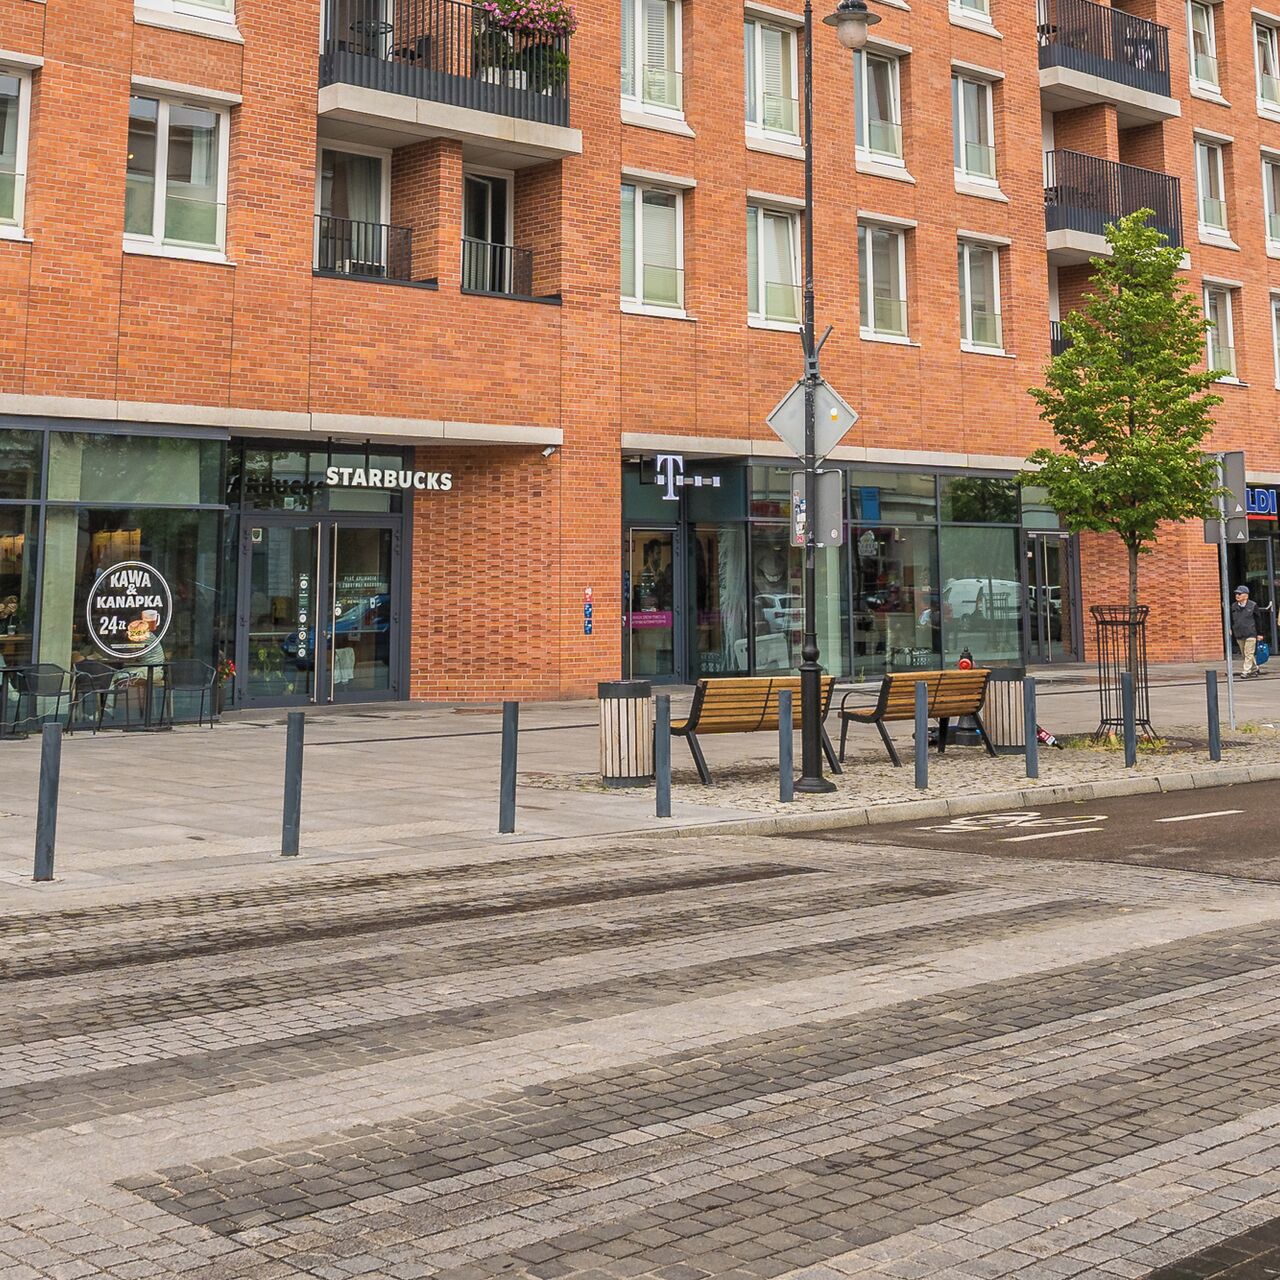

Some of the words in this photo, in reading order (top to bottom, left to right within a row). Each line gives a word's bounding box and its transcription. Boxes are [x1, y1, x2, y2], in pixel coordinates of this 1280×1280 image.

[326, 466, 453, 492] STARBUCKS
[657, 454, 684, 500] T
[1245, 488, 1277, 513] LDI
[110, 570, 151, 588] KAWA
[96, 595, 163, 608] KANAPKA
